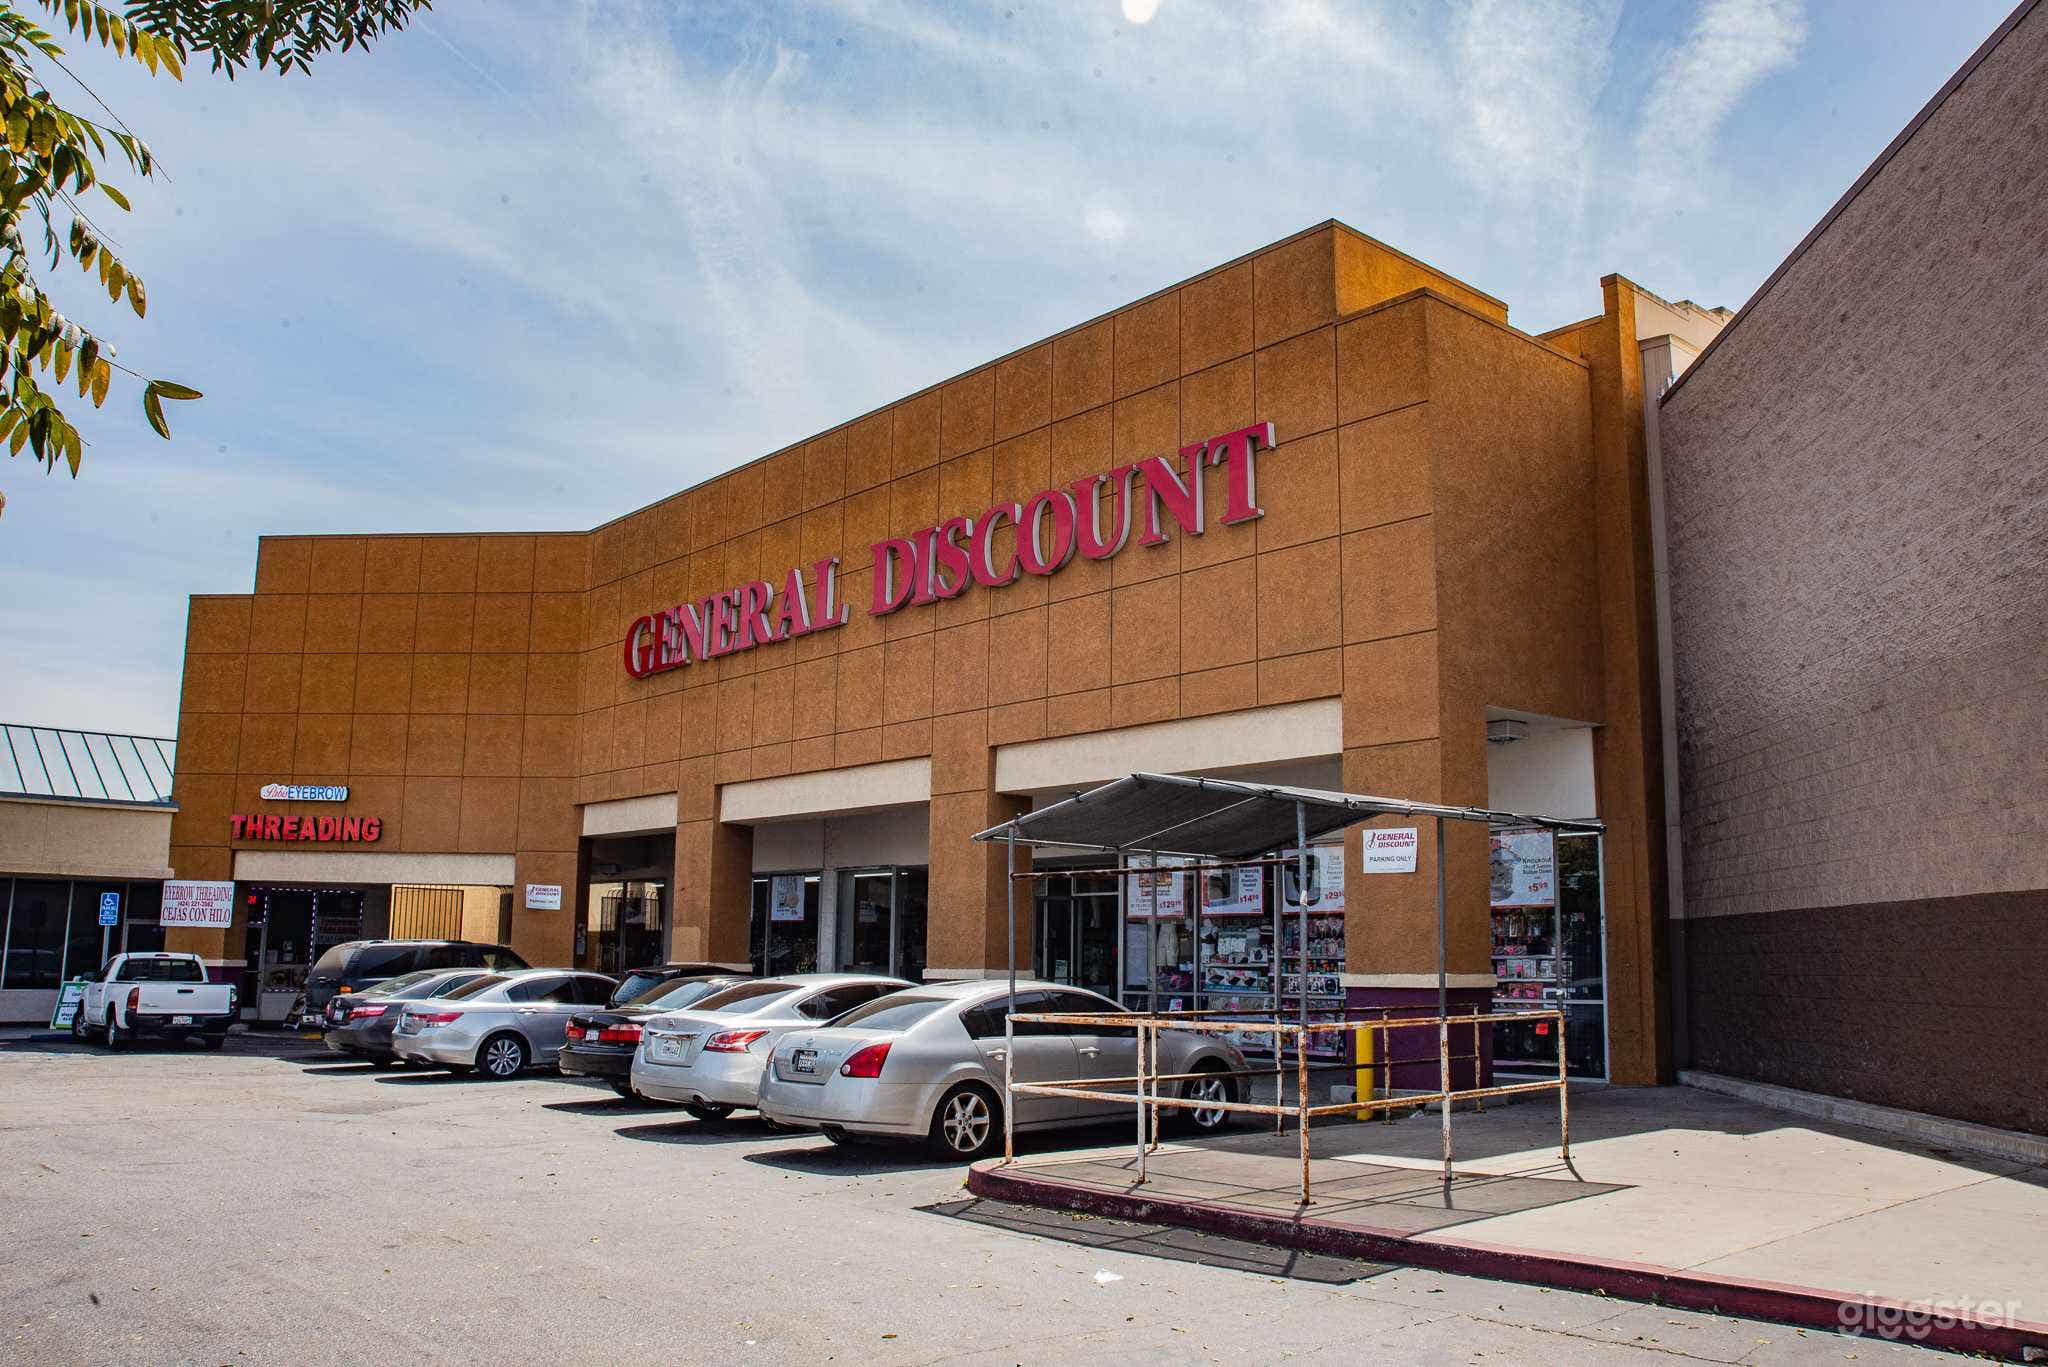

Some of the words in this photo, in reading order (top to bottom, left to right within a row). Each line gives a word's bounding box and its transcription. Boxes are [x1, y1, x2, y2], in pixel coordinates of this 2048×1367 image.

[624, 557, 849, 679] GENERAL
[868, 421, 1276, 617] DISCOUNT
[288, 786, 345, 800] EYEBROW
[230, 815, 382, 841] THREADING
[1376, 833, 1415, 841] GENERAL
[164, 885, 193, 900] EYEBROW
[196, 886, 233, 901] THREADING
[163, 907, 187, 920] CEJAS
[189, 907, 208, 921] CON
[209, 908, 231, 922] HILO
